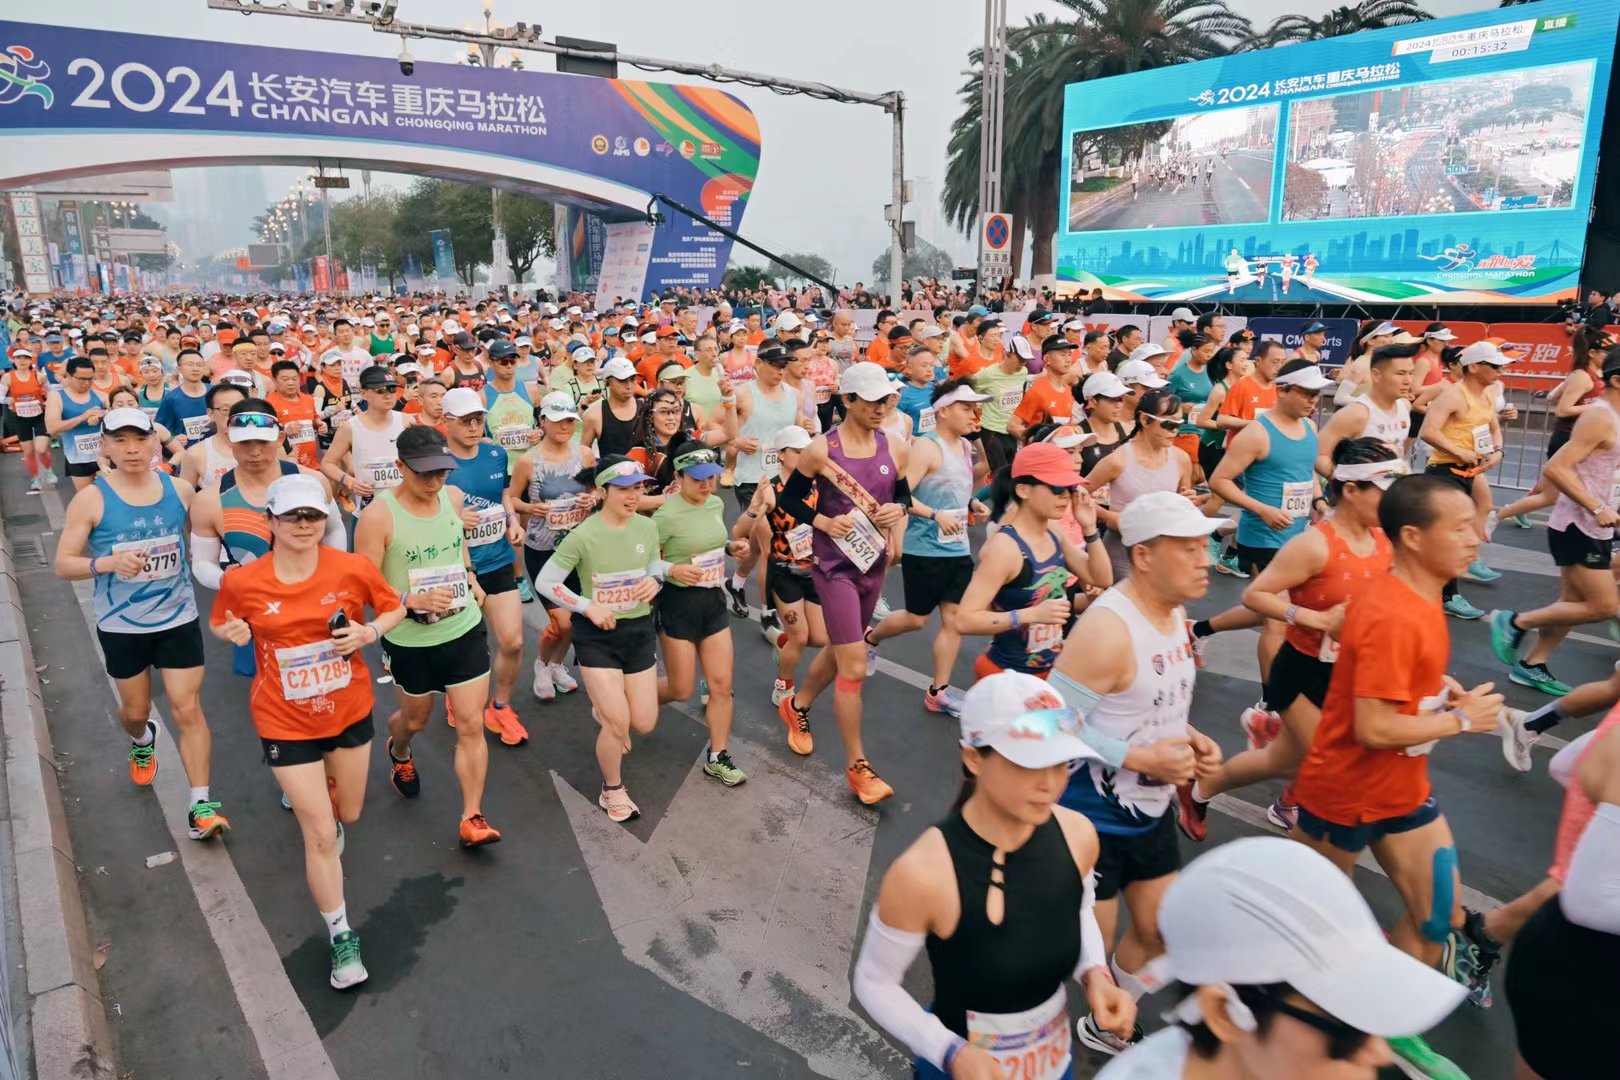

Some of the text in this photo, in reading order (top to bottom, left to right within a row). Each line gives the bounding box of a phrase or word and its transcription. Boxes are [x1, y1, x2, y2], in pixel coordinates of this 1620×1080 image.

[1406, 40, 1431, 51] 2024
[1467, 25, 1524, 41] 重庆马拉松
[1452, 42, 1508, 57] 00:15:32
[67, 57, 243, 117] 2024
[1217, 82, 1270, 105] 2024
[1274, 83, 1325, 96] CHANGAN
[251, 103, 548, 136] CHANGAN CHONGQING MARATHON
[374, 468, 404, 482] 0840
[463, 520, 503, 541] C06087
